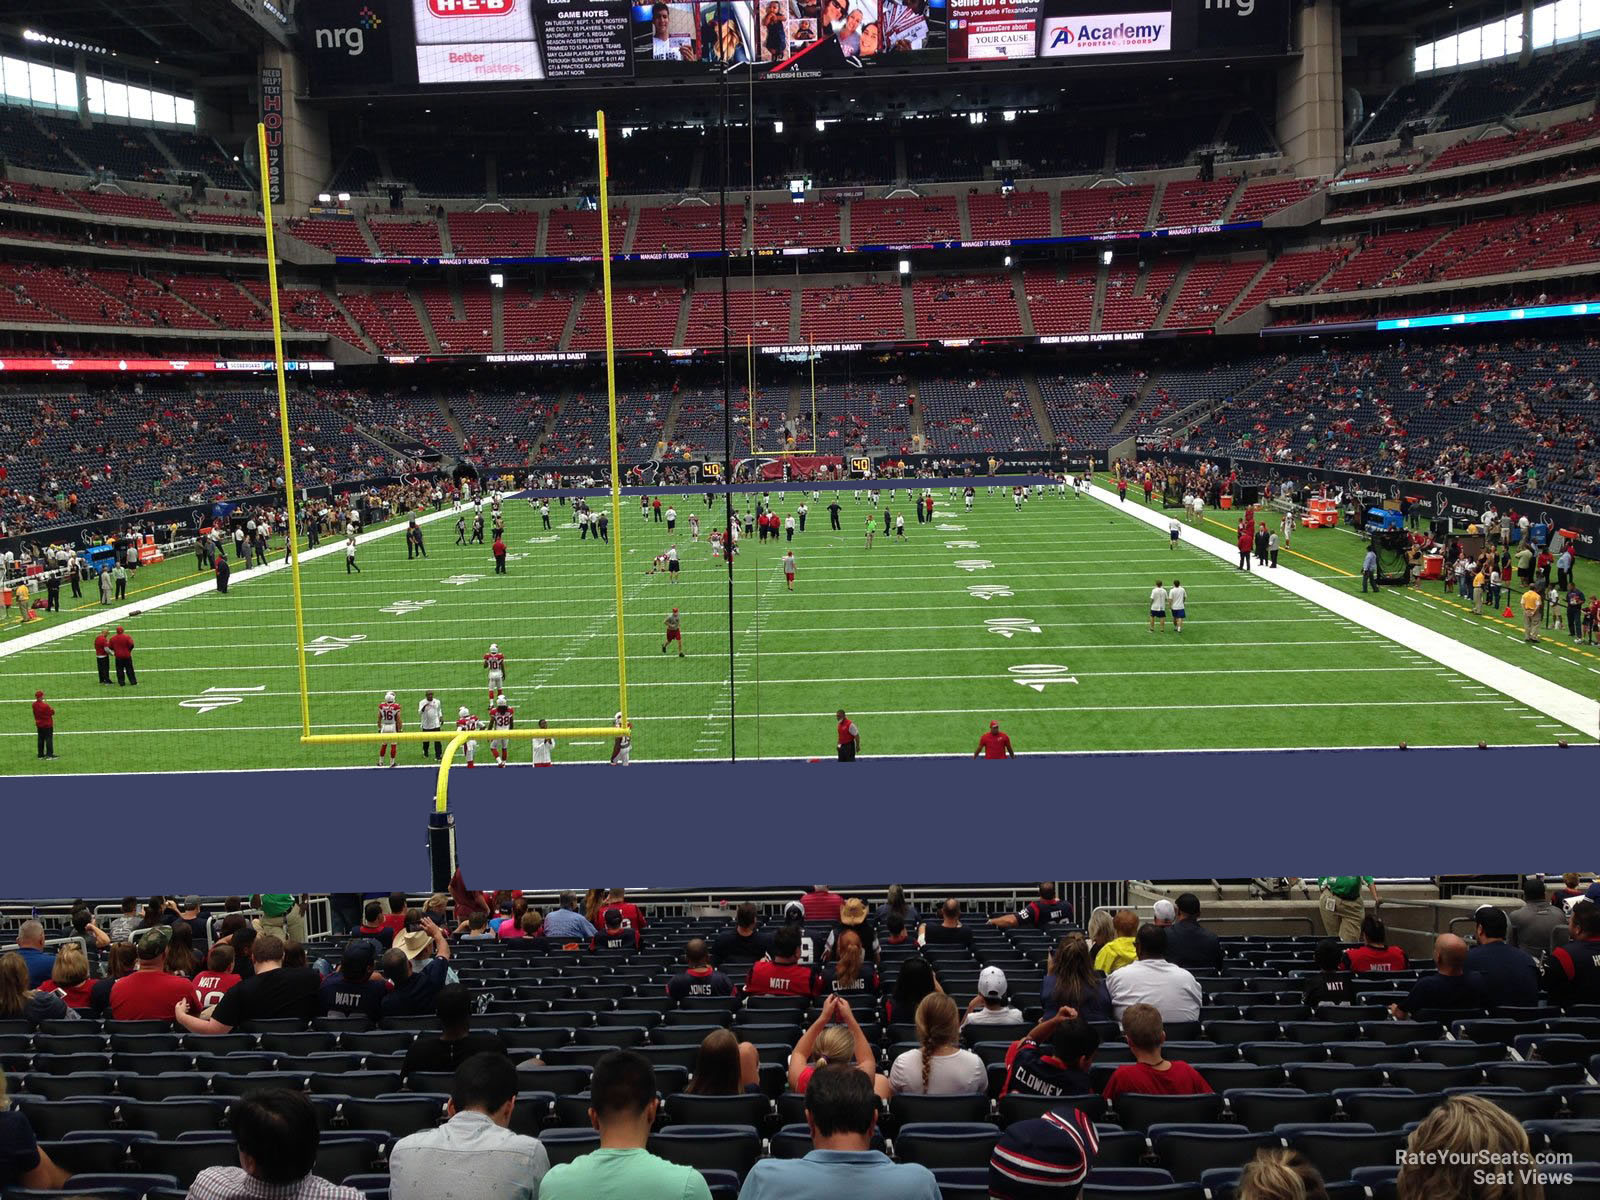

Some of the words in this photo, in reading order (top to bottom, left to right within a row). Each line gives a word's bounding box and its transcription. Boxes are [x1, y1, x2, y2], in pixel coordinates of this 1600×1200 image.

[1077, 23, 1162, 41] Academy
[316, 28, 364, 56] nrg
[976, 35, 1000, 44] YOUR
[1001, 34, 1028, 43] CAUSE
[448, 52, 485, 63] Better
[475, 64, 524, 74] matters.
[264, 86, 280, 94] TEXT
[704, 464, 719, 475] 40
[854, 460, 868, 470] 40
[383, 710, 393, 720] 16
[497, 716, 509, 727] 38
[608, 939, 622, 948] WATT
[198, 977, 220, 989] WATT
[770, 978, 790, 990] WATT
[1326, 982, 1344, 991] WATT
[689, 984, 711, 995] JONES
[335, 992, 361, 1007] WATT
[1016, 1066, 1063, 1096] CLOWNEY
